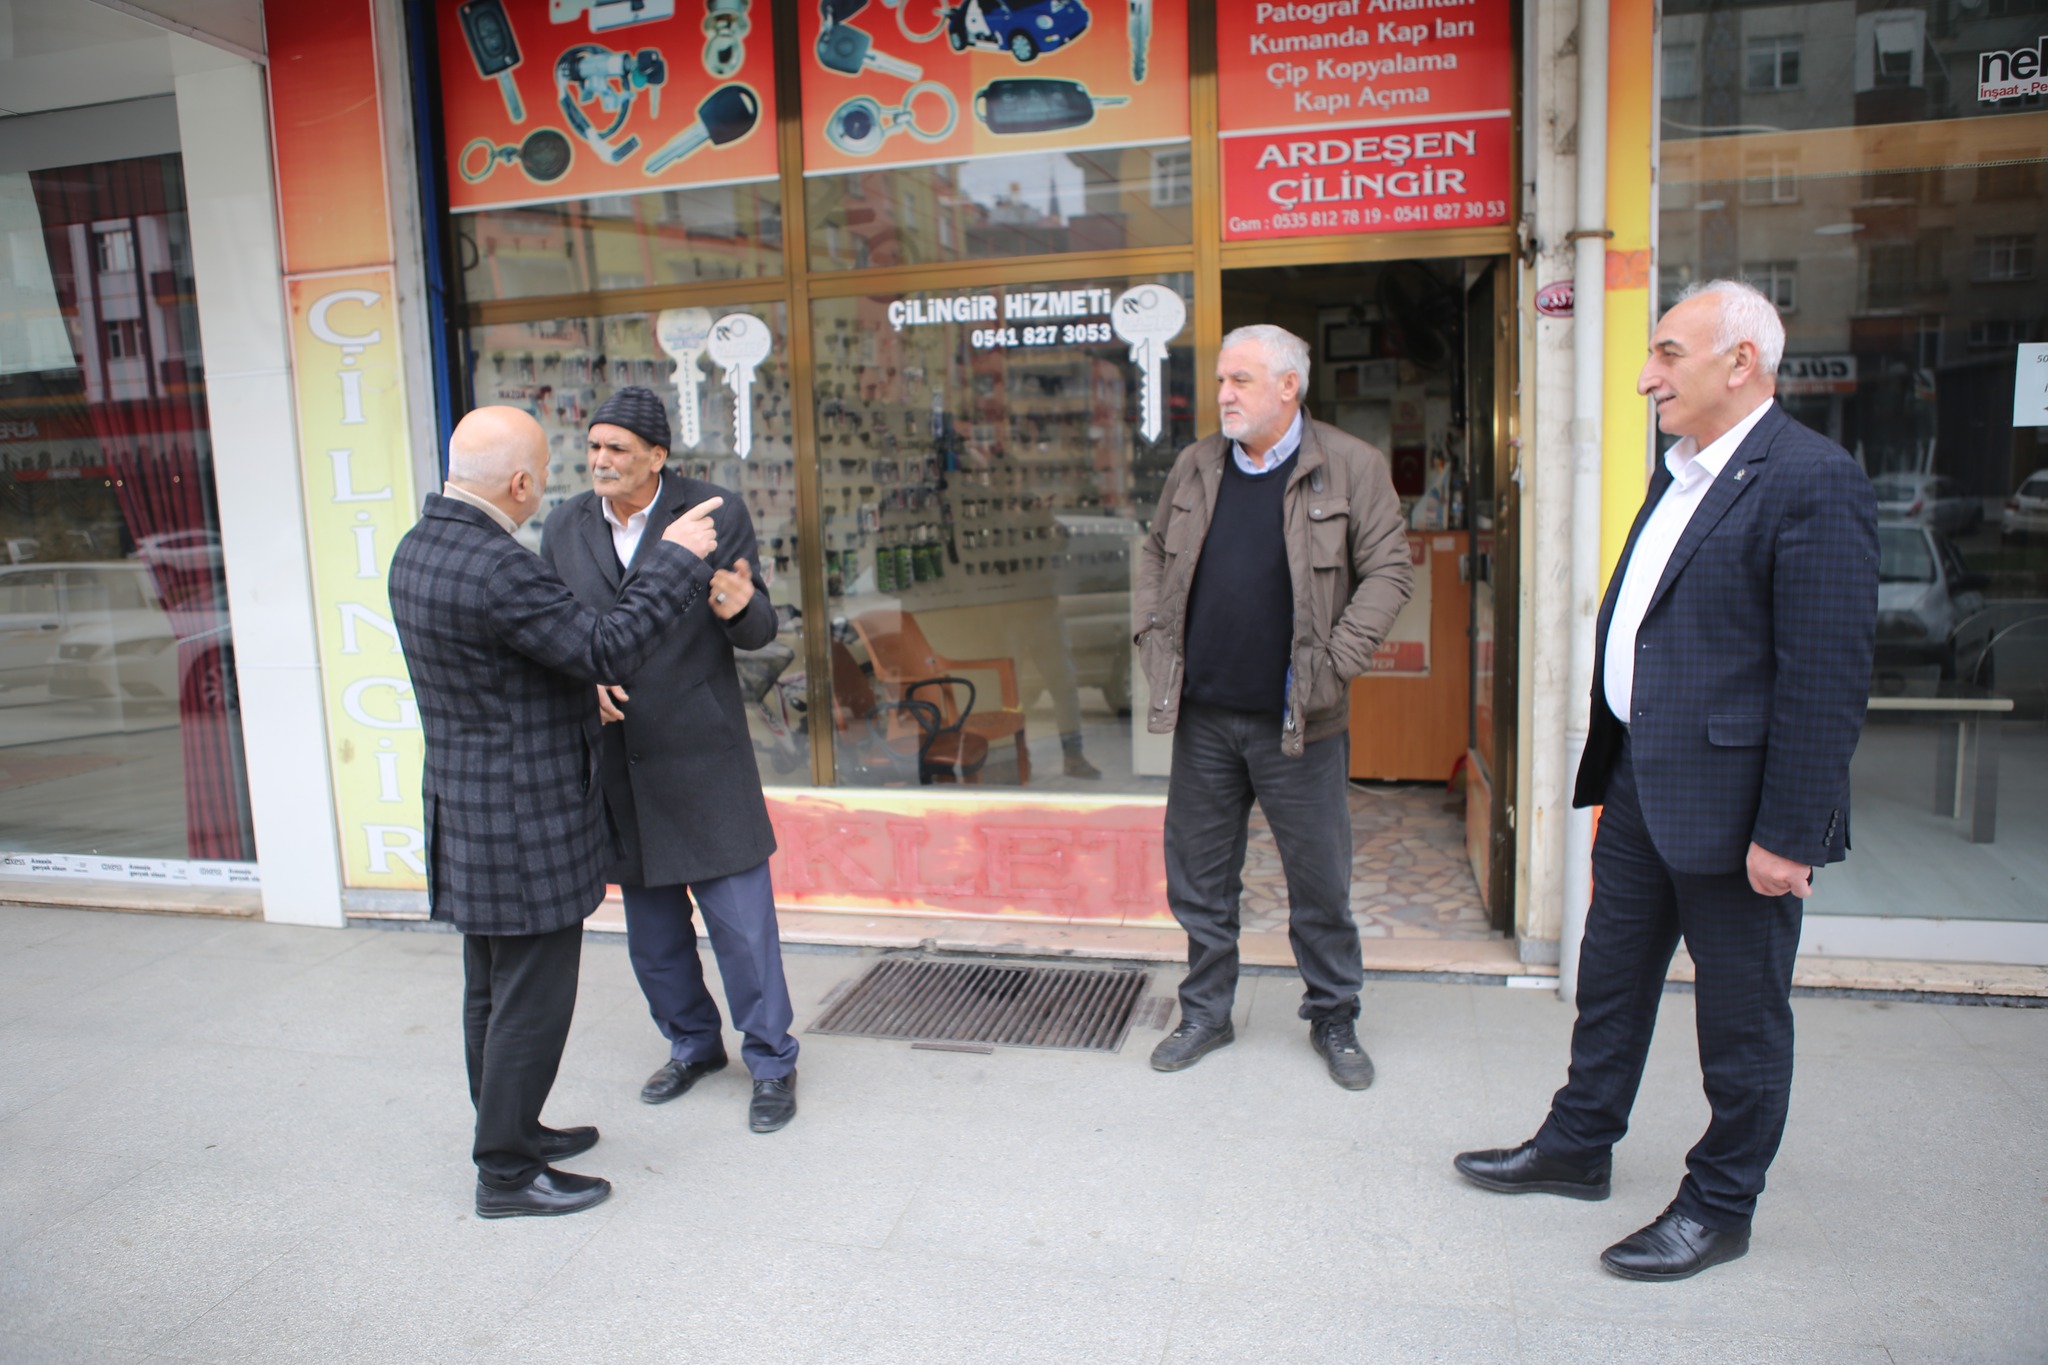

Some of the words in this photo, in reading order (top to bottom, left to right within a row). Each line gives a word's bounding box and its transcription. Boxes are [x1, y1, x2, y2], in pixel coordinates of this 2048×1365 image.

[1256, 0, 1360, 24] Patograf
[1250, 26, 1369, 55] Kumanda
[1266, 62, 1309, 88] Çip
[1316, 52, 1457, 82] Kopyalama
[1294, 91, 1350, 115] Kapı
[1357, 86, 1430, 110] Açma
[1980, 84, 2018, 99] İnşaat
[1255, 130, 1477, 169] ARDEŞEN
[1267, 164, 1467, 210] ÇİLİNGİR
[1229, 216, 1262, 233] Gsm
[1273, 213, 1308, 230] 0535
[1311, 211, 1339, 228] 812
[1342, 209, 1361, 226] 78
[1363, 207, 1382, 224] 19
[1393, 205, 1429, 222] 0541
[1433, 203, 1461, 220] 827
[1464, 201, 1484, 218] 30
[1486, 200, 1506, 216] 53
[971, 327, 1019, 348] 0541
[1023, 325, 1058, 346] 827
[1063, 322, 1112, 343] 3053
